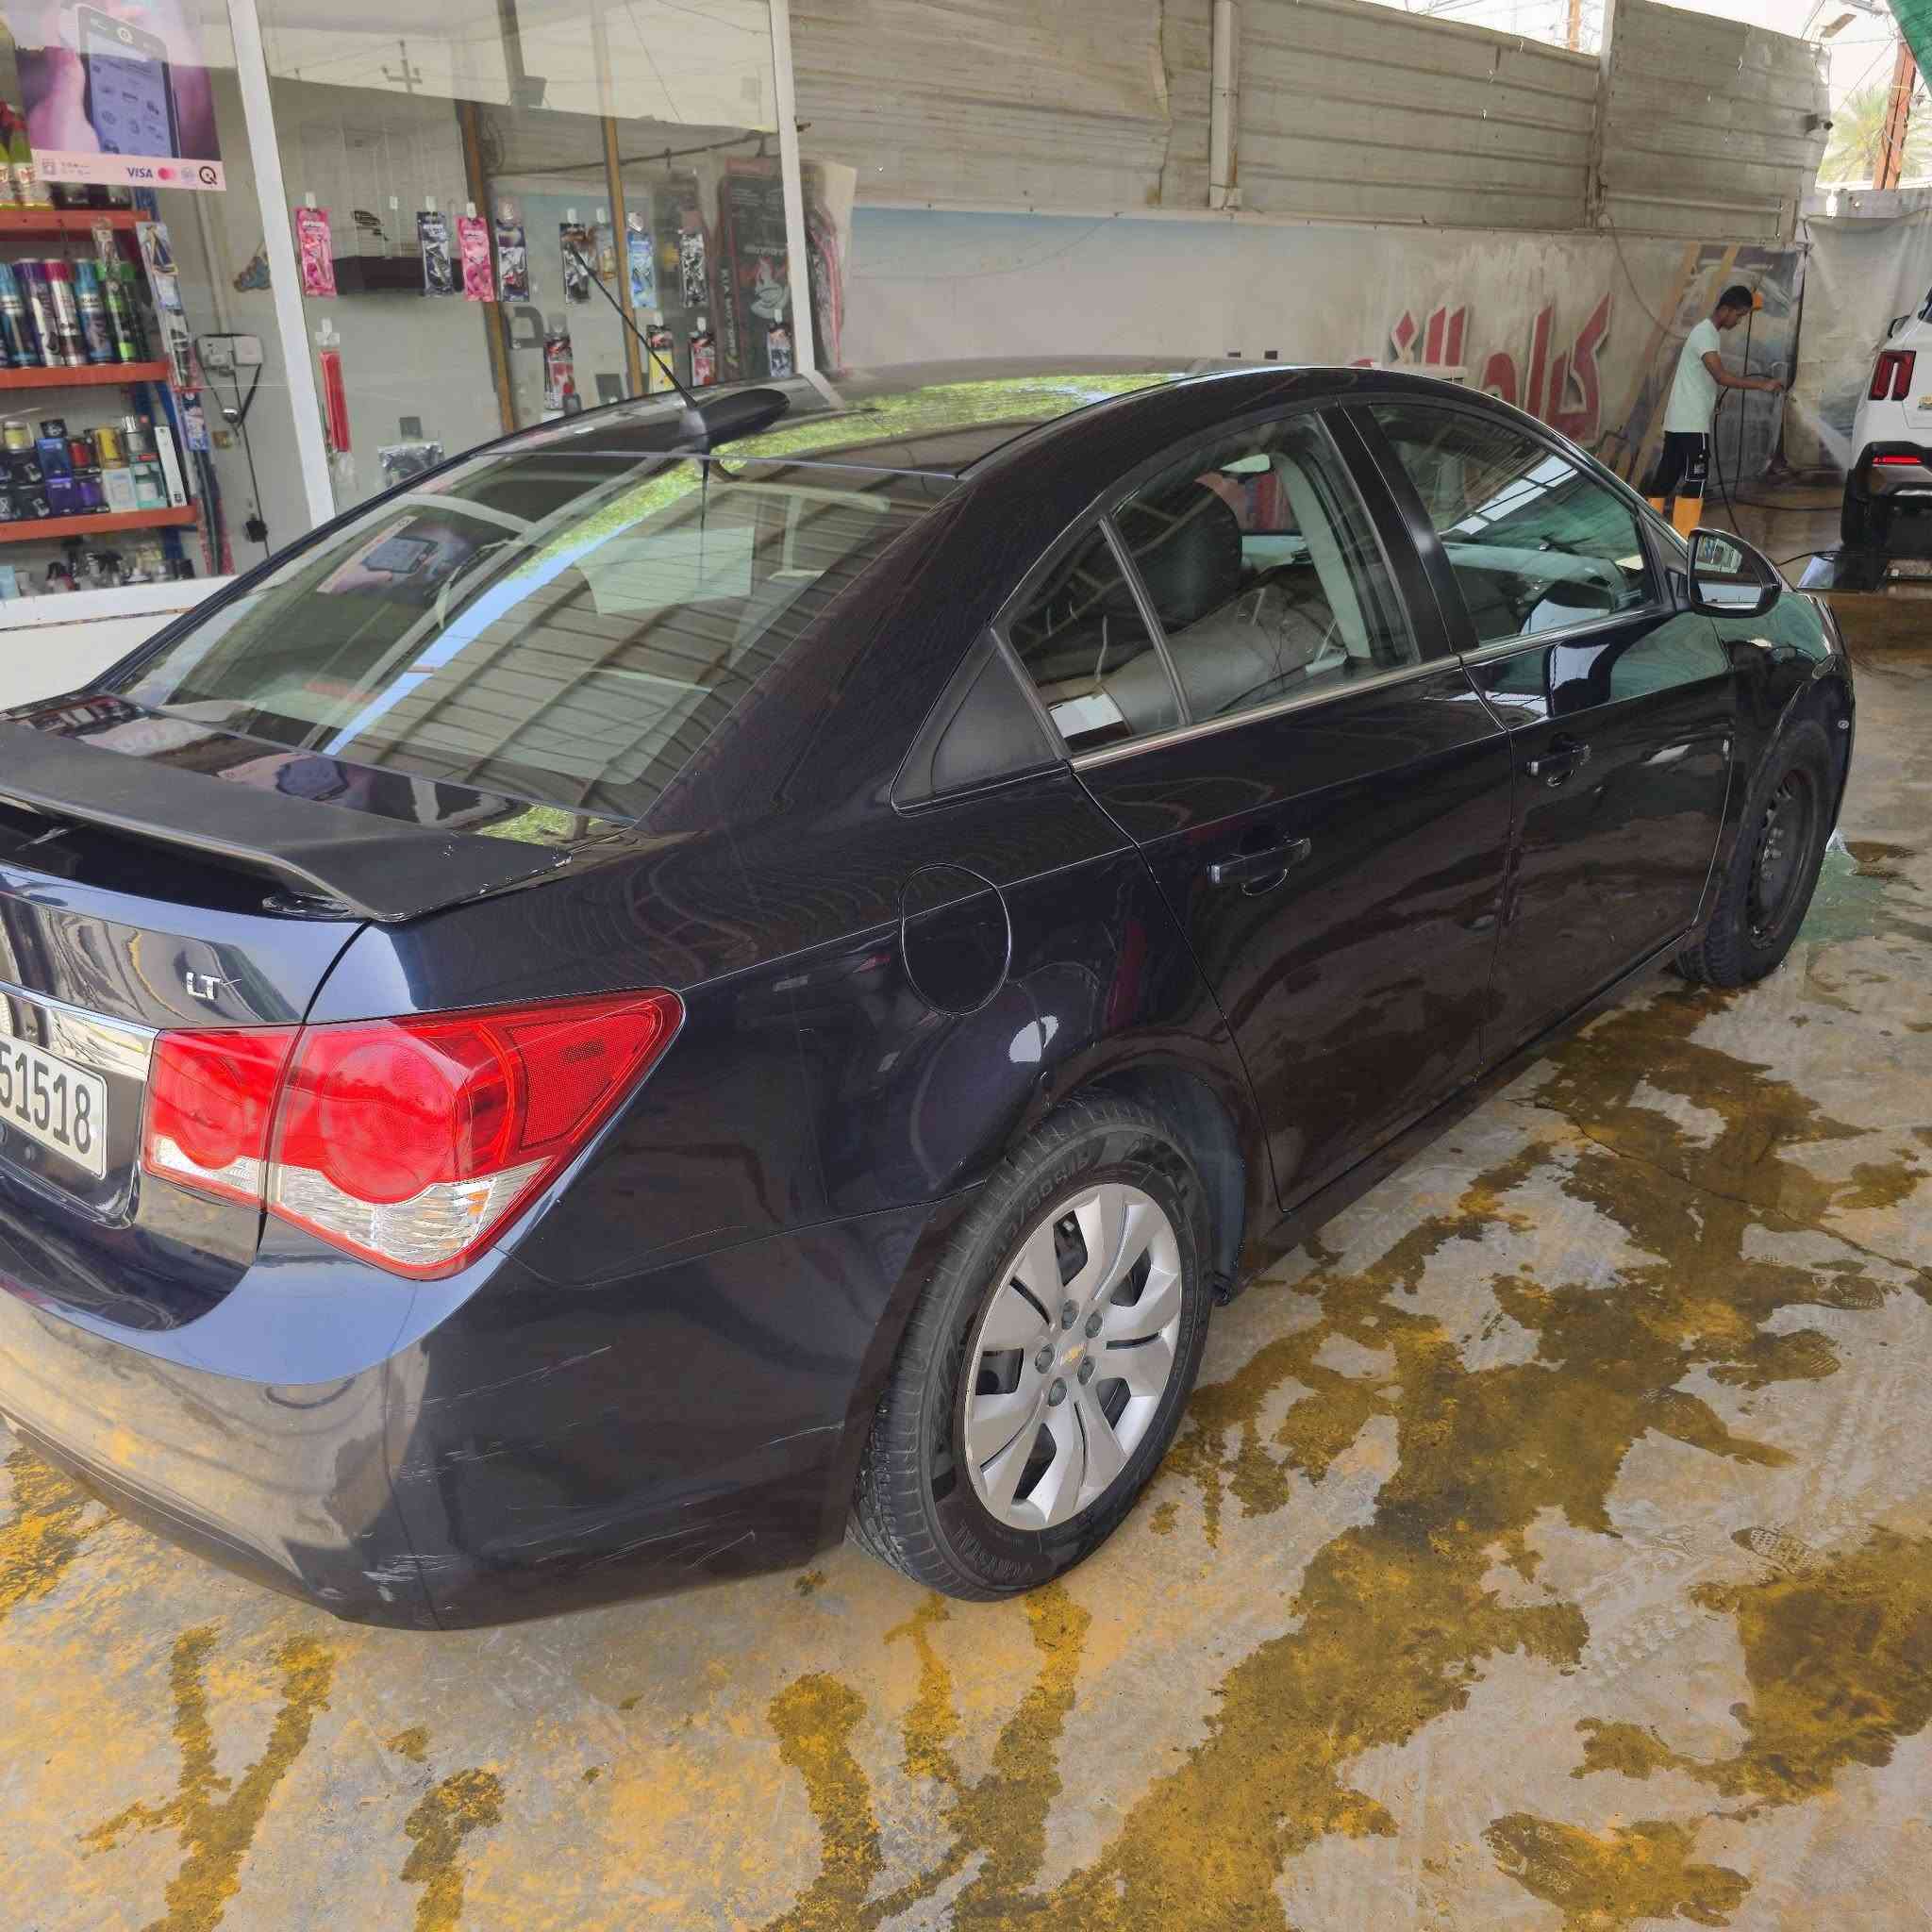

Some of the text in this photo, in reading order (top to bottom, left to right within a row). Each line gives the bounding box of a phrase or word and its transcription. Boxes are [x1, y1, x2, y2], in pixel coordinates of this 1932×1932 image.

[126, 167, 154, 179] VISA
[186, 972, 221, 1000] LT
[0, 1041, 92, 1155] 51518
